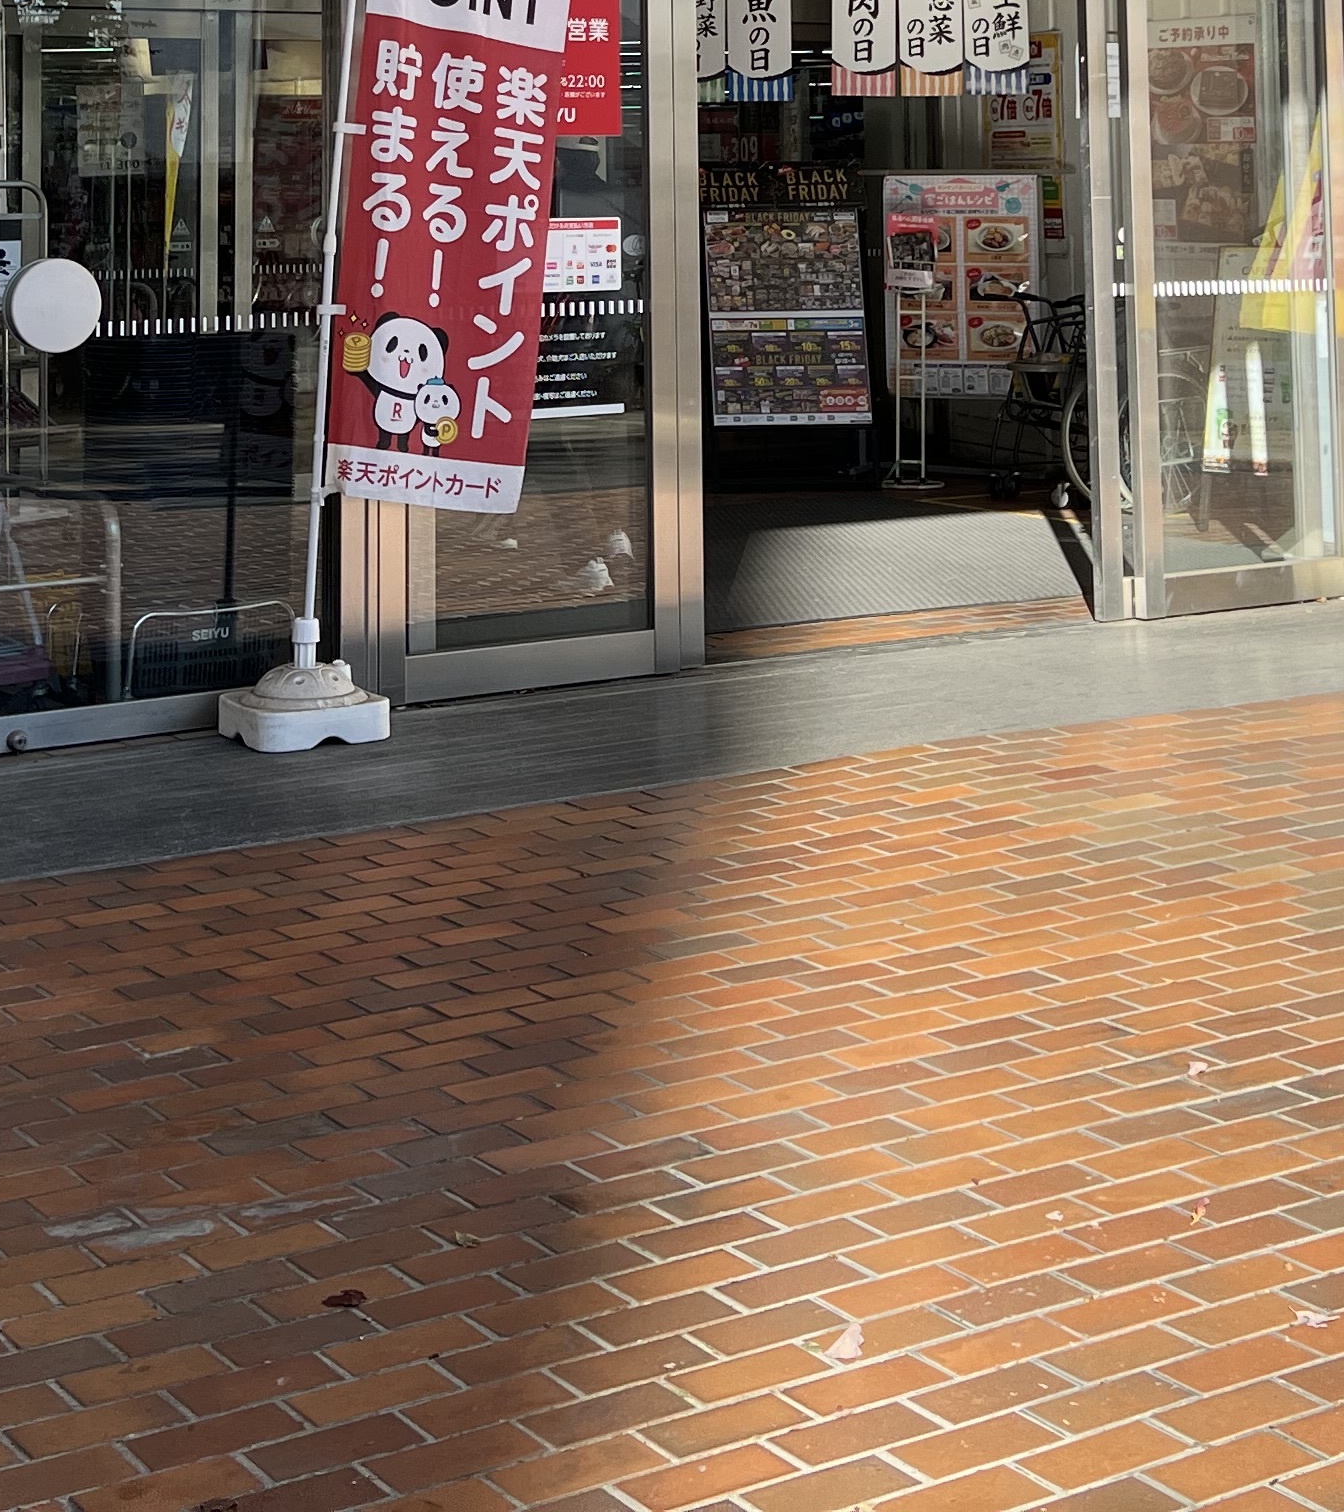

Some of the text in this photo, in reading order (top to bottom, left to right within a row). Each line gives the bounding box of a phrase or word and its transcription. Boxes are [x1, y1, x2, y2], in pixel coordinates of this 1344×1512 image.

[906, 18, 926, 58] の日
[971, 17, 991, 58] の日
[1158, 25, 1230, 43] ご予約承り中
[699, 171, 760, 187] BLACK
[786, 168, 848, 185] BLACK
[699, 187, 760, 202] FRIDAY
[788, 183, 849, 201] FRIDAY
[470, 63, 549, 442] 楽天ポイント
[337, 458, 502, 499] 楽天ポイントカード
[191, 626, 230, 641] SEIYU
